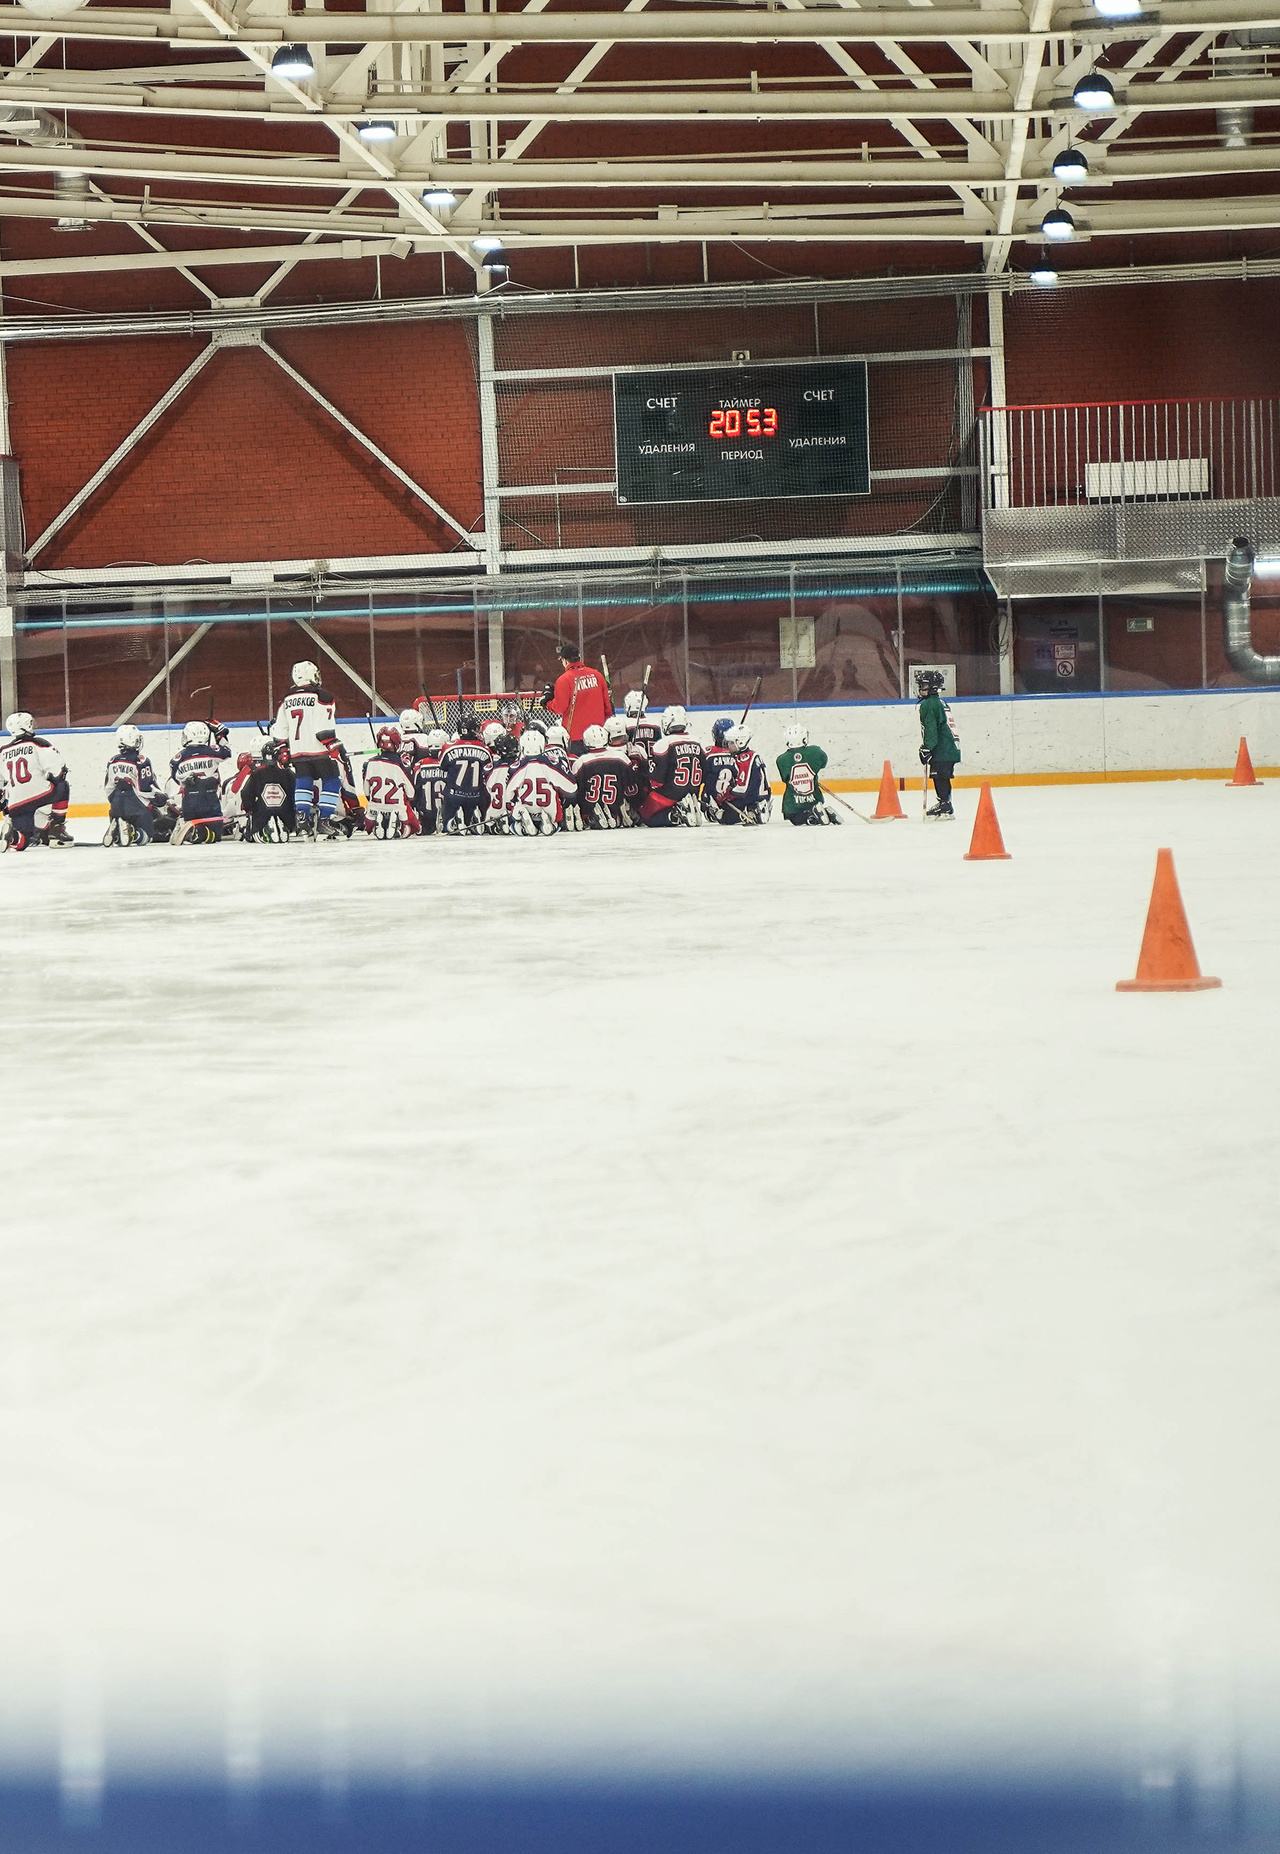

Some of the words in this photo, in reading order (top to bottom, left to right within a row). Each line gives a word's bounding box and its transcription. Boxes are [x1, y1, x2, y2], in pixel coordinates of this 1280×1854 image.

[646, 397, 678, 410] СЧЕТ
[719, 397, 761, 409] ТАЙМЕР
[803, 389, 835, 401] СЧЕТ
[638, 443, 696, 455] УДАЛЕНИЯ
[721, 450, 763, 460] ПЕРИОД
[789, 436, 846, 448] УДАЛЕНИЯ
[291, 709, 304, 740] 7
[326, 708, 332, 720] 7
[6, 757, 33, 788] 10
[455, 759, 481, 788] 71
[674, 756, 703, 787] 56
[715, 768, 733, 794] 8
[368, 776, 400, 805] 22
[519, 777, 552, 808] 25
[585, 774, 618, 805] 35
